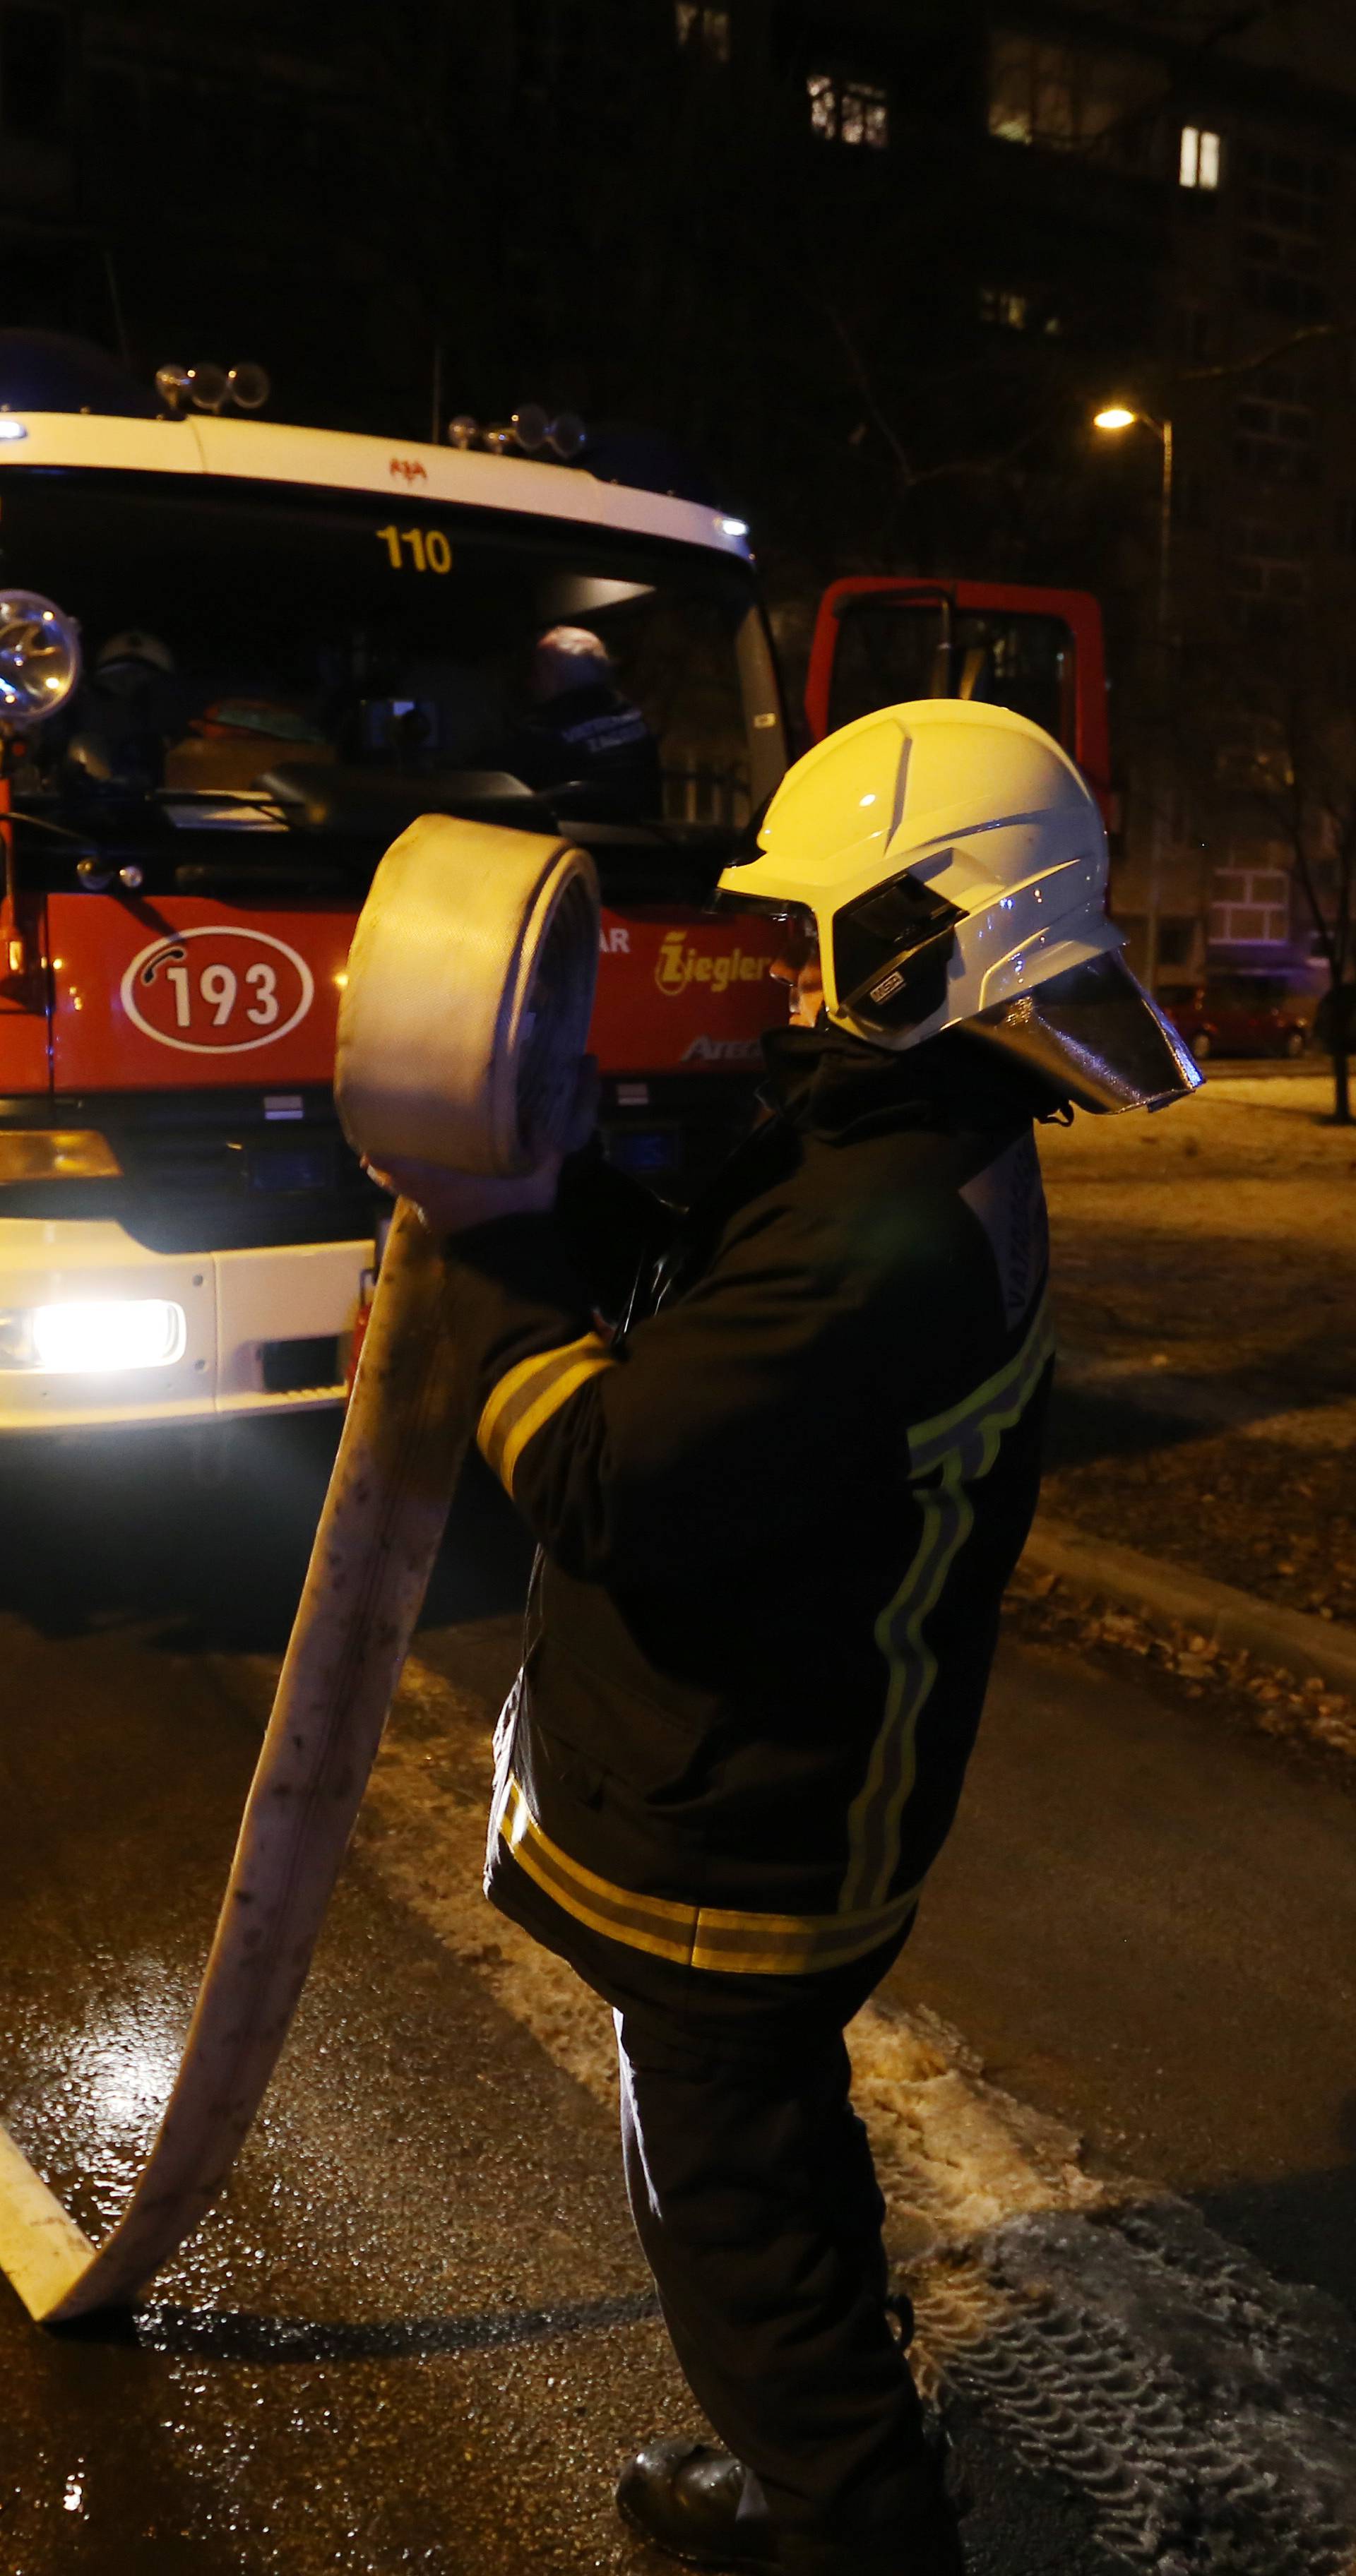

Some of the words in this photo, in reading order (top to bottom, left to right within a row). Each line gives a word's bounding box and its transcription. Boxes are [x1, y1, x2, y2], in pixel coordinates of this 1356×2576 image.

[375, 524, 453, 575] 110
[655, 930, 773, 996] Ziegler
[872, 974, 902, 1000] MSA
[167, 962, 279, 1027] 193
